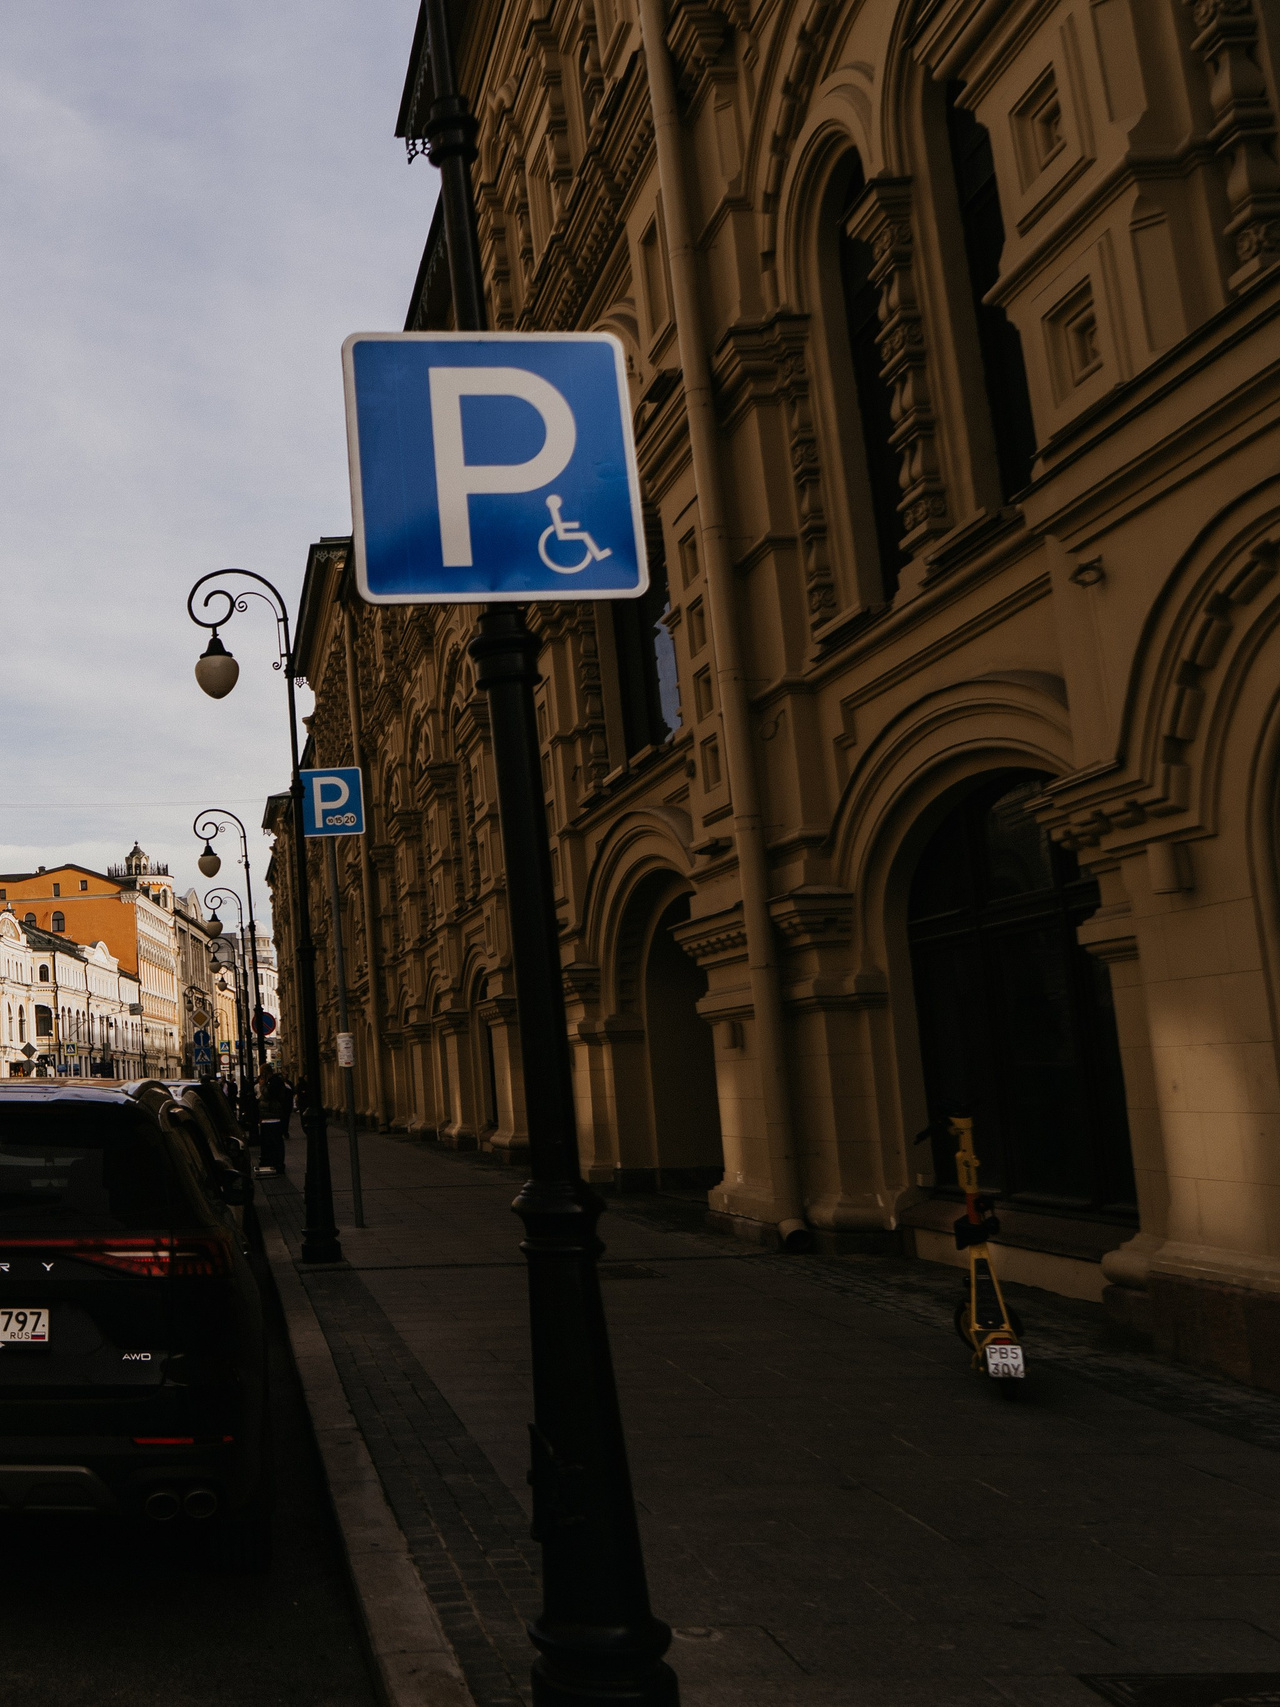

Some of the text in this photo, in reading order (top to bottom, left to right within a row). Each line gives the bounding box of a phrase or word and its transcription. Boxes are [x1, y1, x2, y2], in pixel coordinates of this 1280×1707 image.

[428, 366, 577, 568] P
[312, 776, 350, 829] P
[335, 816, 343, 824] 15
[344, 815, 356, 824] 20
[0, 1311, 42, 1332] 797
[9, 1331, 30, 1340] RUS
[122, 1353, 152, 1361] AWD
